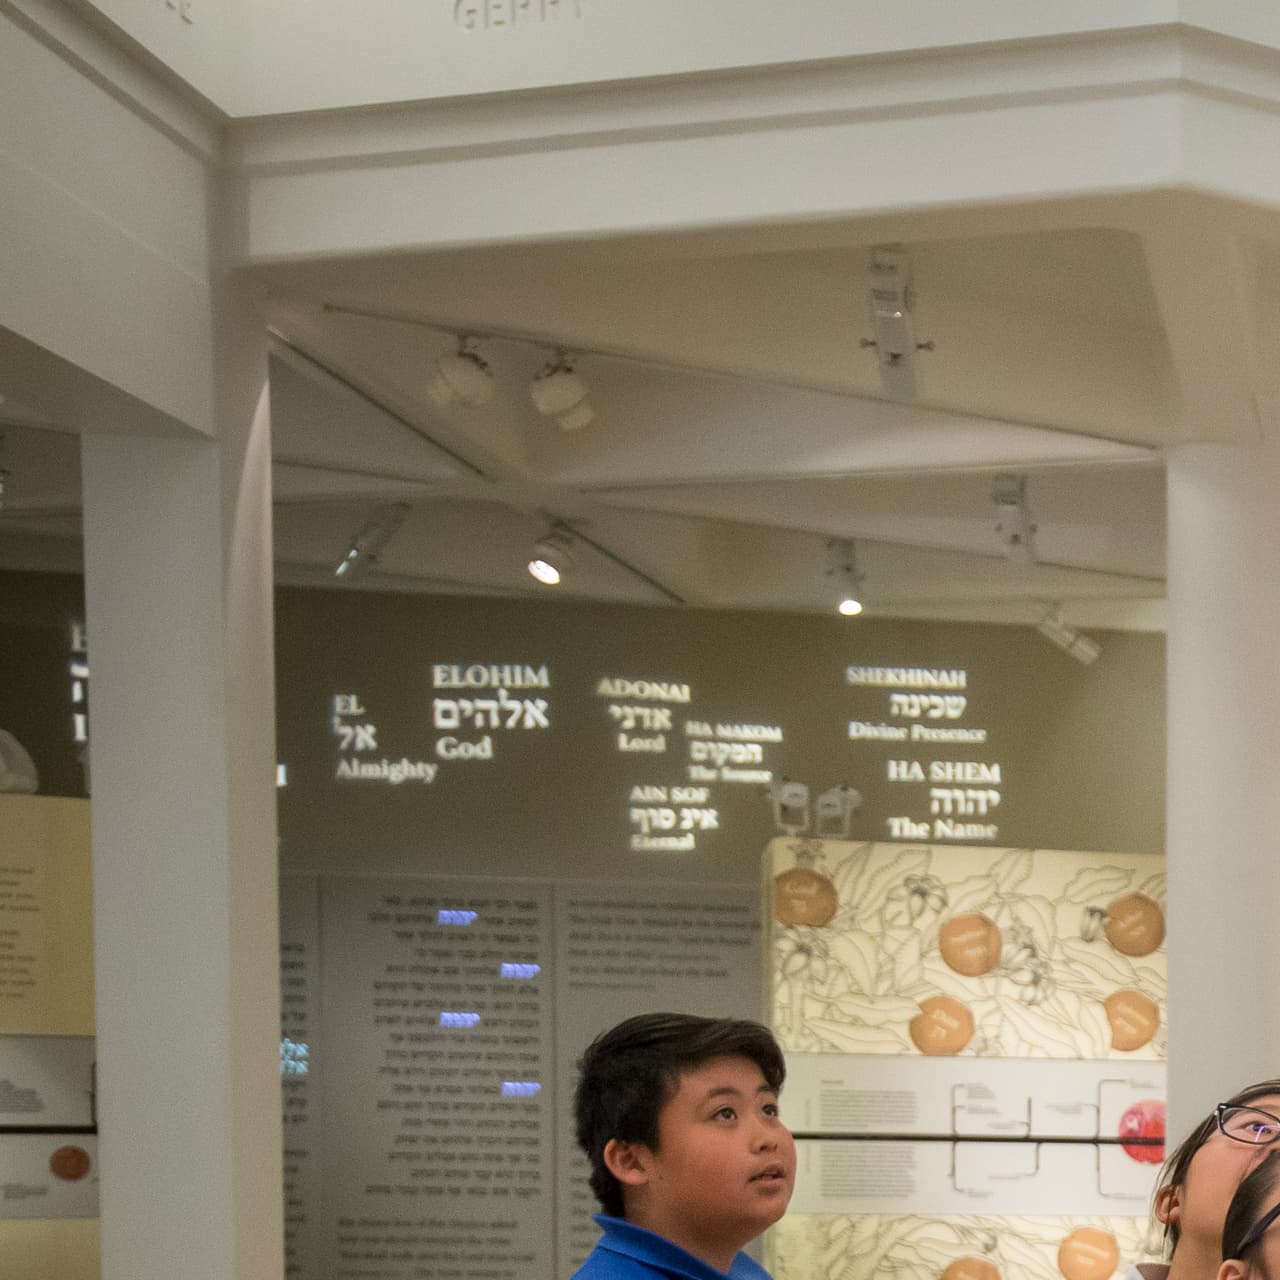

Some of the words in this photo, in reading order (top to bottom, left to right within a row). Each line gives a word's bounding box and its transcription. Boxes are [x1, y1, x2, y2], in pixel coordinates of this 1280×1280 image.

[432, 664, 550, 689] ELOHIM
[596, 677, 691, 703] ADONAI
[334, 694, 365, 716] EL
[433, 688, 550, 729] אלהים
[333, 716, 378, 751] אל
[617, 732, 666, 753] Lord
[435, 735, 493, 760] God
[337, 757, 438, 784] Almighty
[887, 759, 925, 782] HA
[929, 760, 1002, 785] SHEM
[930, 787, 1001, 815] יהוה
[888, 816, 930, 839] The
[933, 818, 999, 841] Name
